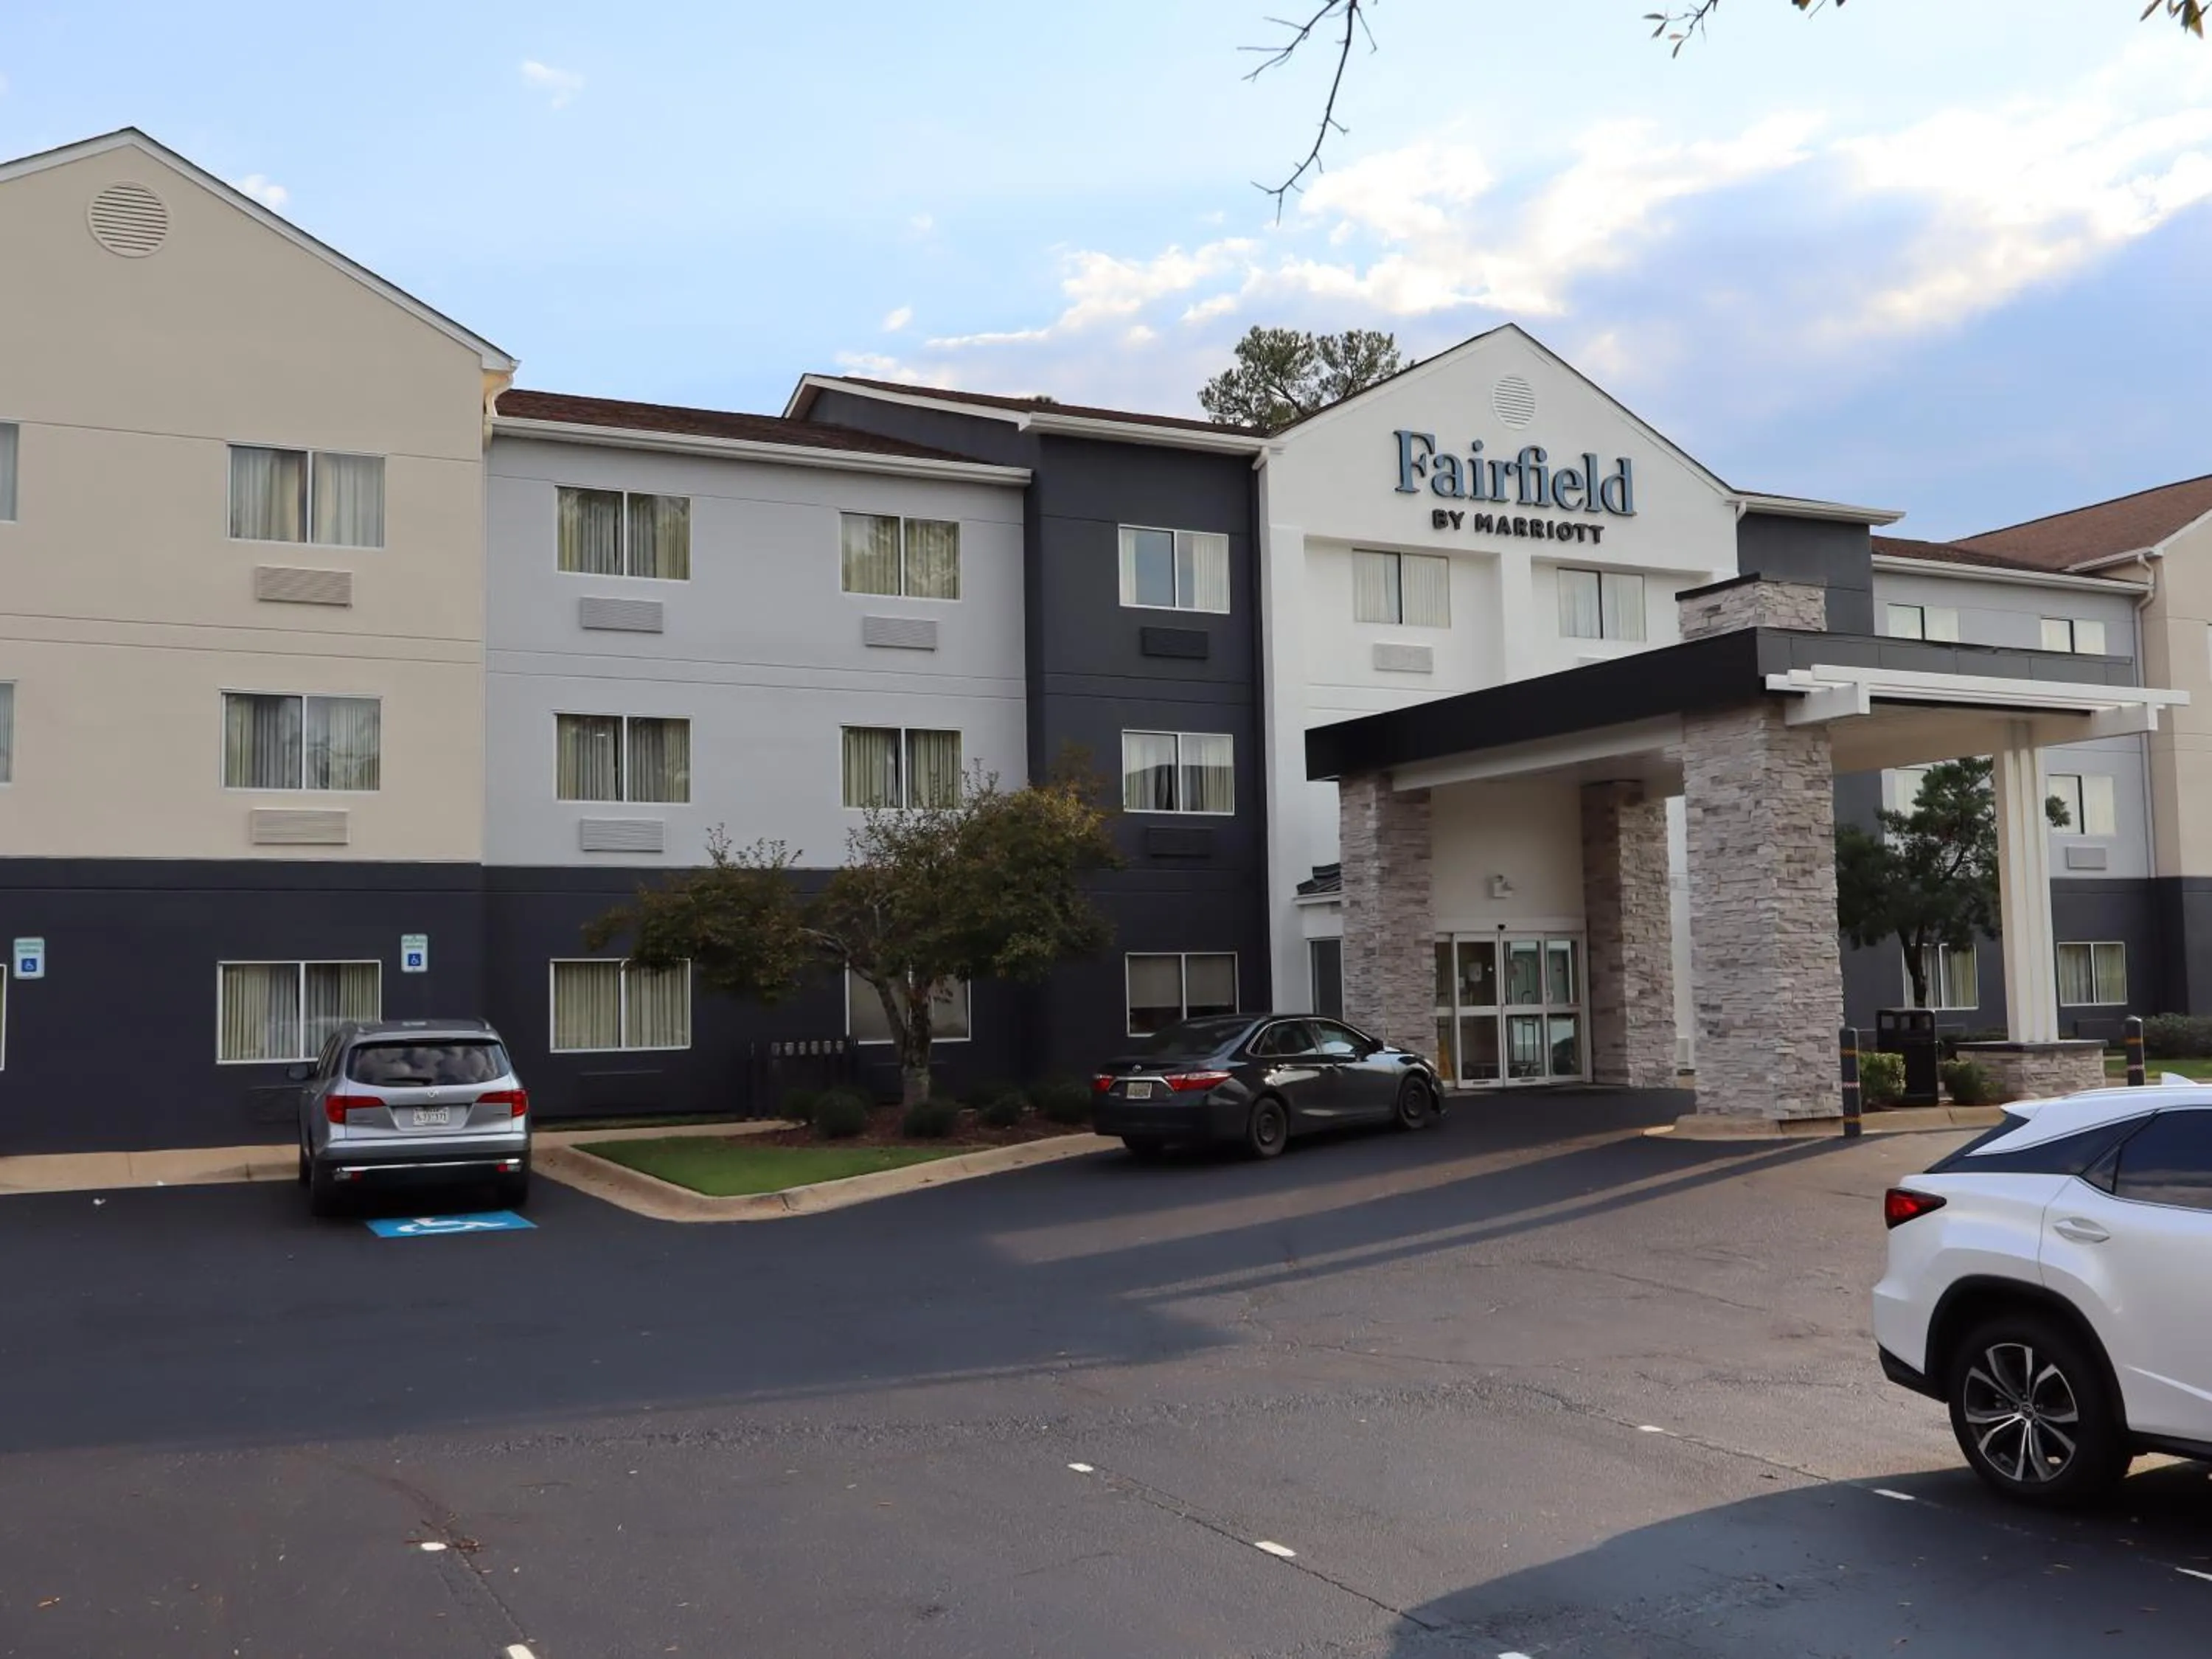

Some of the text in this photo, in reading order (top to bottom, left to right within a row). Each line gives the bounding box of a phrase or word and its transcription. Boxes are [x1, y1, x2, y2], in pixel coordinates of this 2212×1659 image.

[1393, 430, 1637, 518] Fairfield
[1431, 509, 1604, 544] BY MARRIOTT
